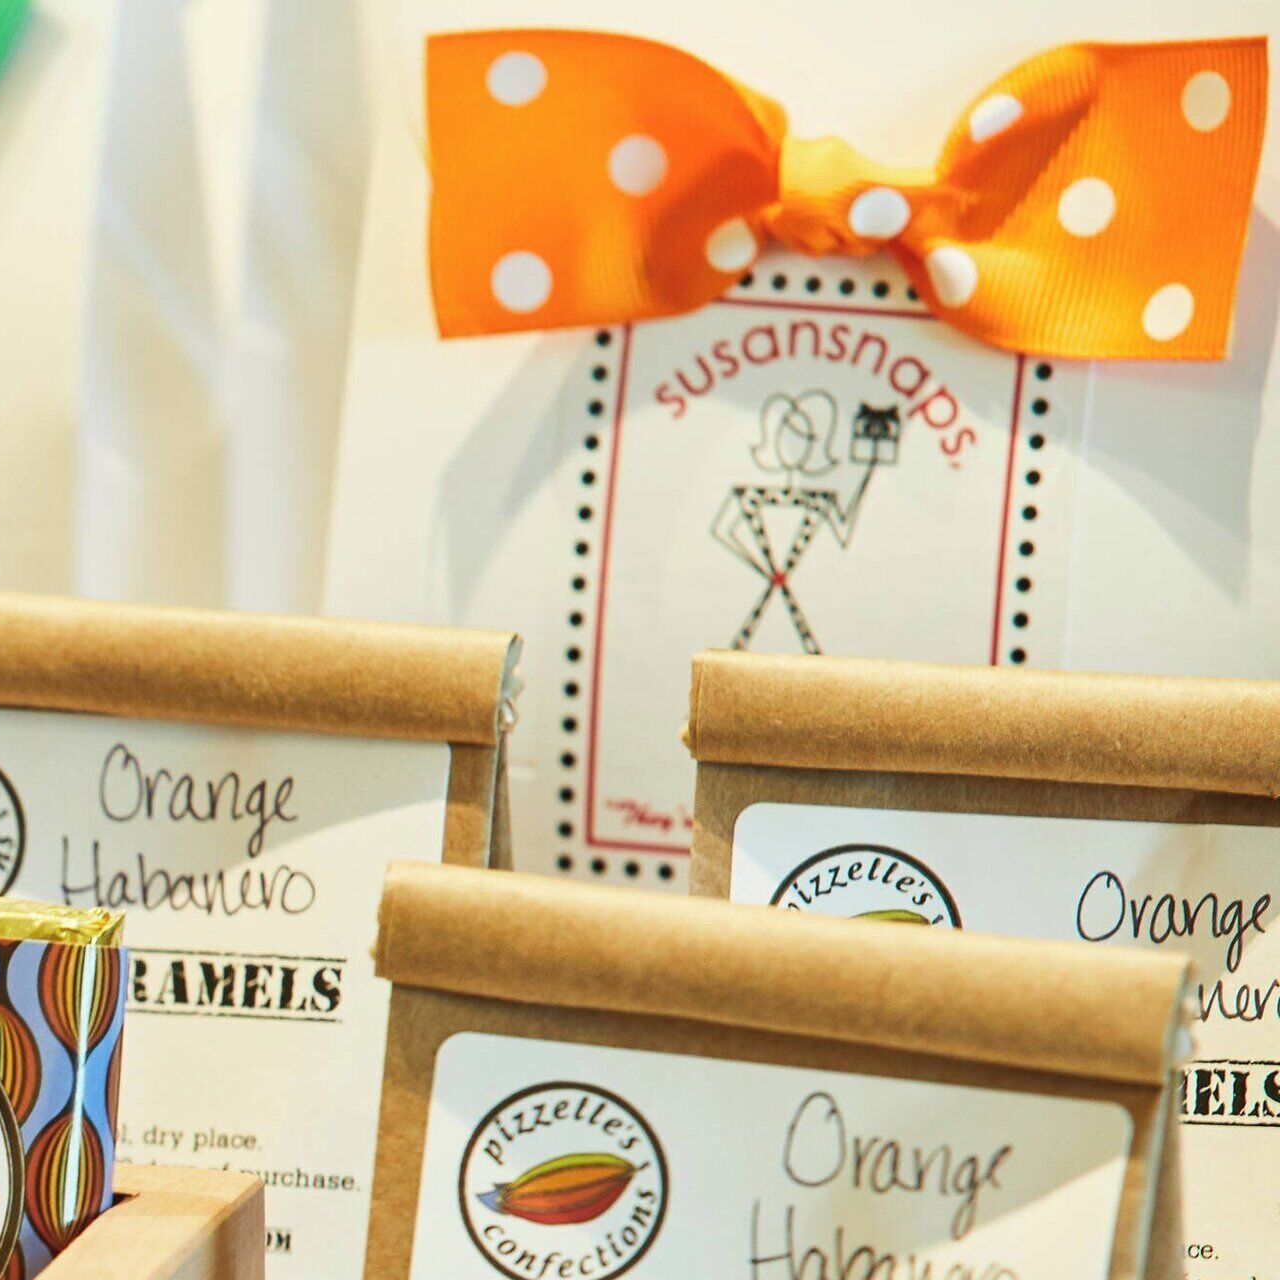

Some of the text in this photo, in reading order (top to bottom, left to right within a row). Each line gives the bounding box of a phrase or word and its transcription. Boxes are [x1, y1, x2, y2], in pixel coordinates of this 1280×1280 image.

[100, 743, 298, 857] Orange
[61, 836, 316, 915] Habanero
[1076, 871, 1271, 973] Orange
[132, 959, 342, 1012] RAMELS
[142, 1125, 183, 1151] dry
[484, 1096, 638, 1164] pizzelle's
[784, 1092, 1014, 1238] Orange
[240, 1167, 362, 1192] urchase.
[483, 1186, 657, 1278] confections
